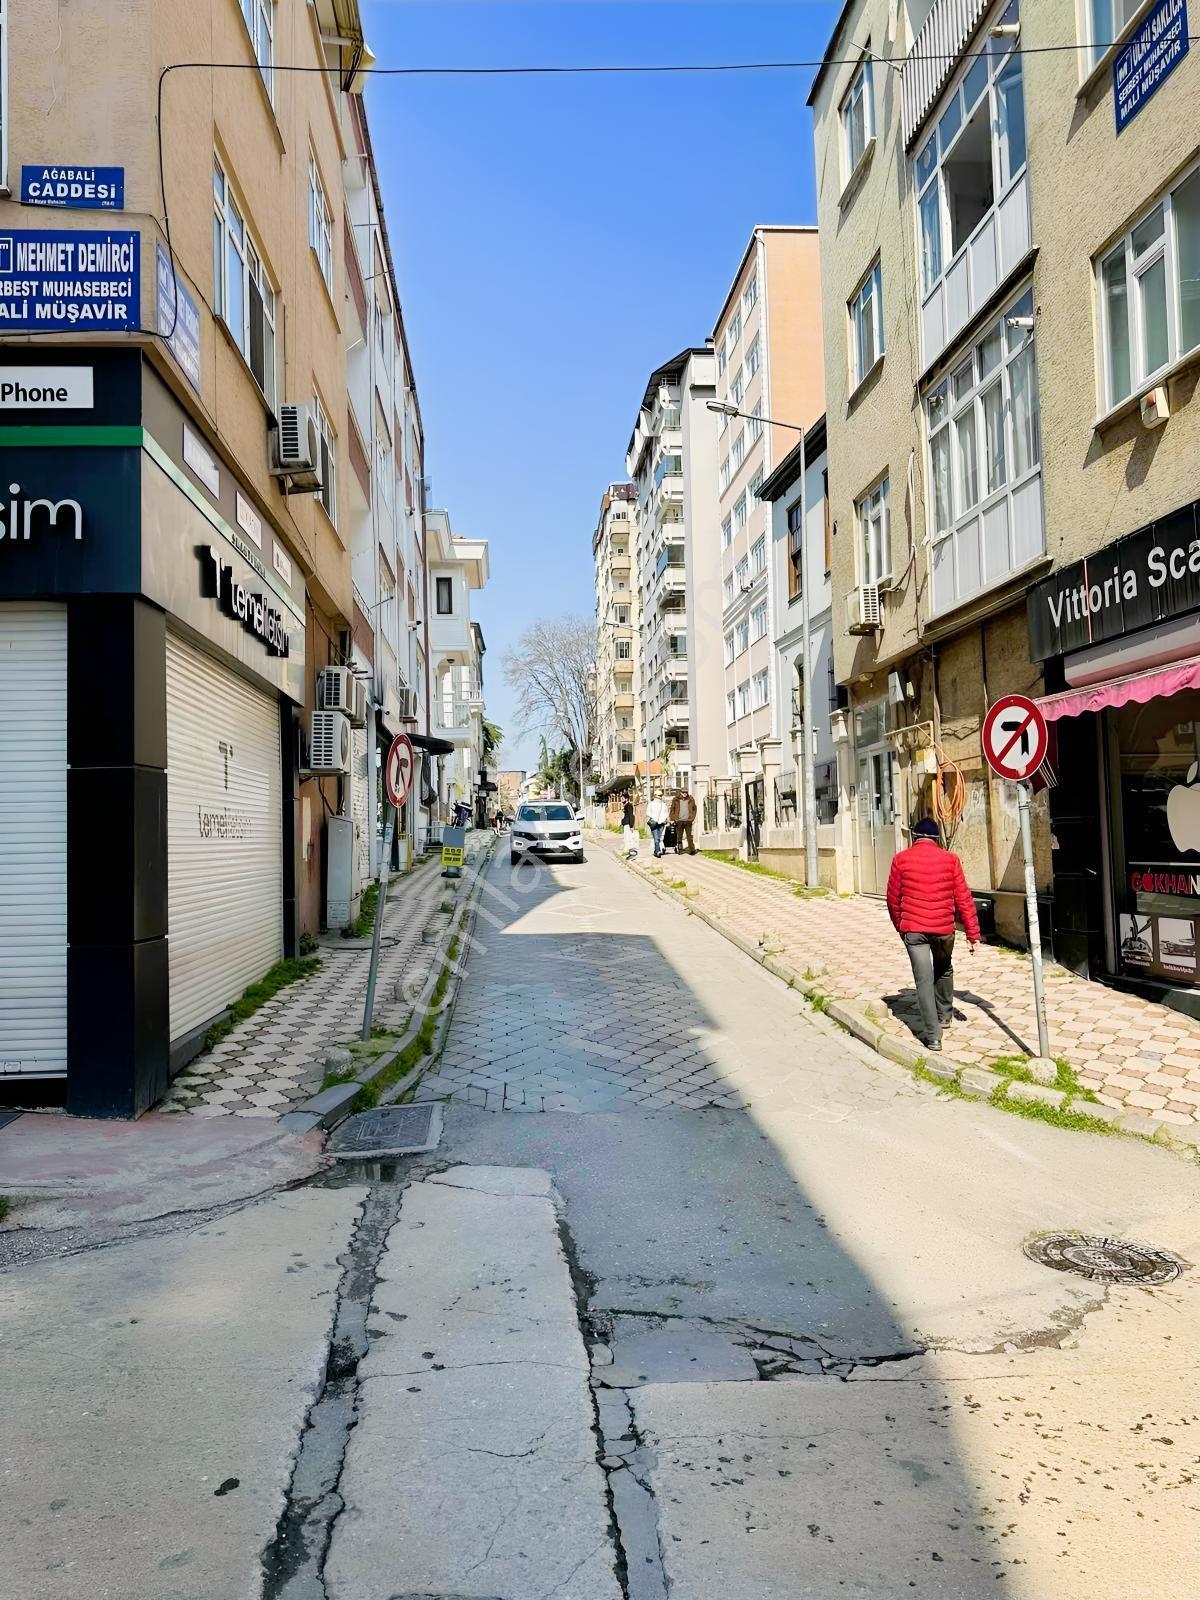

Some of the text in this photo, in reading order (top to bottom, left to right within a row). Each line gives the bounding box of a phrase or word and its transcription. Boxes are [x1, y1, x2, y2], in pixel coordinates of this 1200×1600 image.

[1142, 40, 1181, 95] MÜŞAVİR
[1118, 66, 1143, 105] SERBEST
[42, 168, 95, 181] AĞABALİ
[28, 182, 116, 199] CADDESİ
[17, 242, 75, 272] MEHMET
[78, 236, 134, 273] DEMİRCİ
[43, 277, 132, 297] MUHASEBECİ
[35, 300, 128, 324] MÜŞAVİR
[1048, 566, 1138, 628] Vittoria
